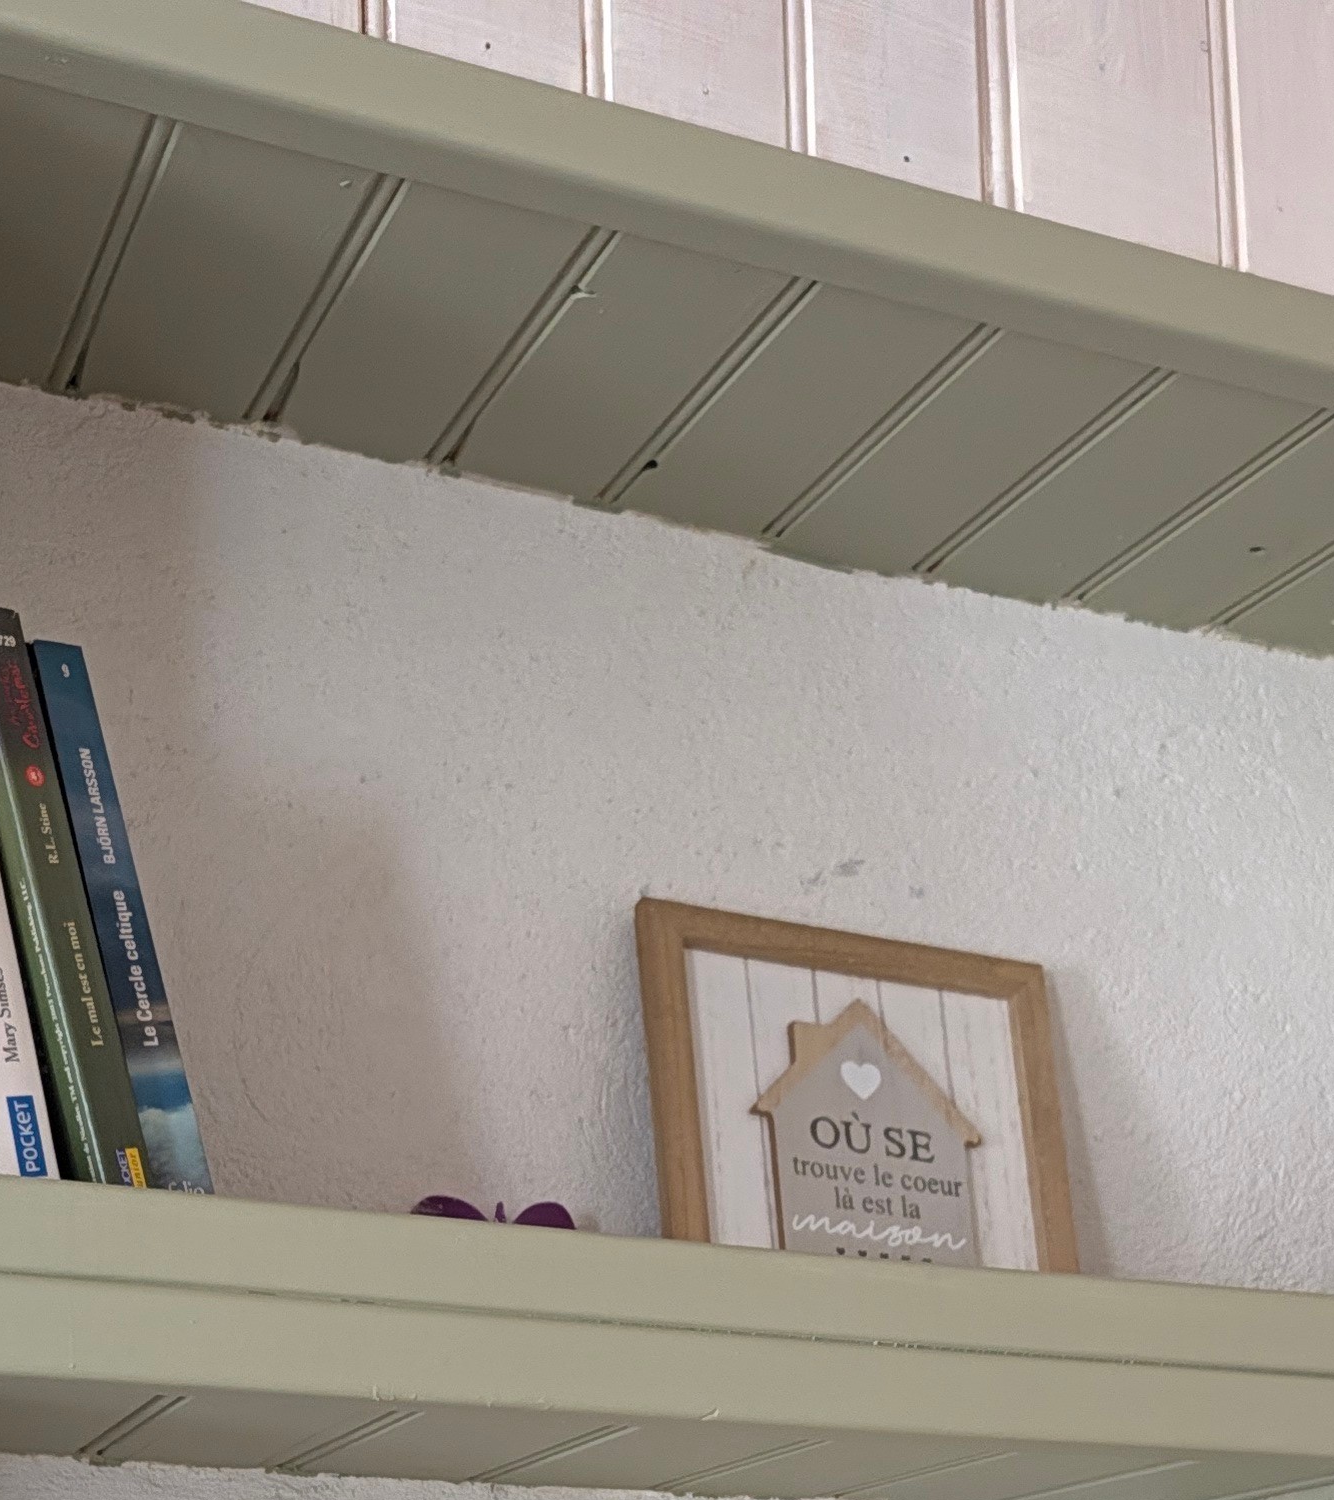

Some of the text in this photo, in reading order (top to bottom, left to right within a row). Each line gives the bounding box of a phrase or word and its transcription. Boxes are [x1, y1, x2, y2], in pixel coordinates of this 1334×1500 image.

[79, 748, 116, 864] BJÖRN LARSSON
[39, 803, 59, 864] R.L. Stine
[63, 921, 104, 1046] Le mal est en moi
[113, 890, 159, 1047] Le Cercle celtique
[5, 1022, 19, 1063] Mary
[810, 1111, 935, 1164] OÙ SE
[793, 1157, 962, 1197] trouve le coeur
[834, 1186, 921, 1219] là est la
[792, 1214, 965, 1250] maison
